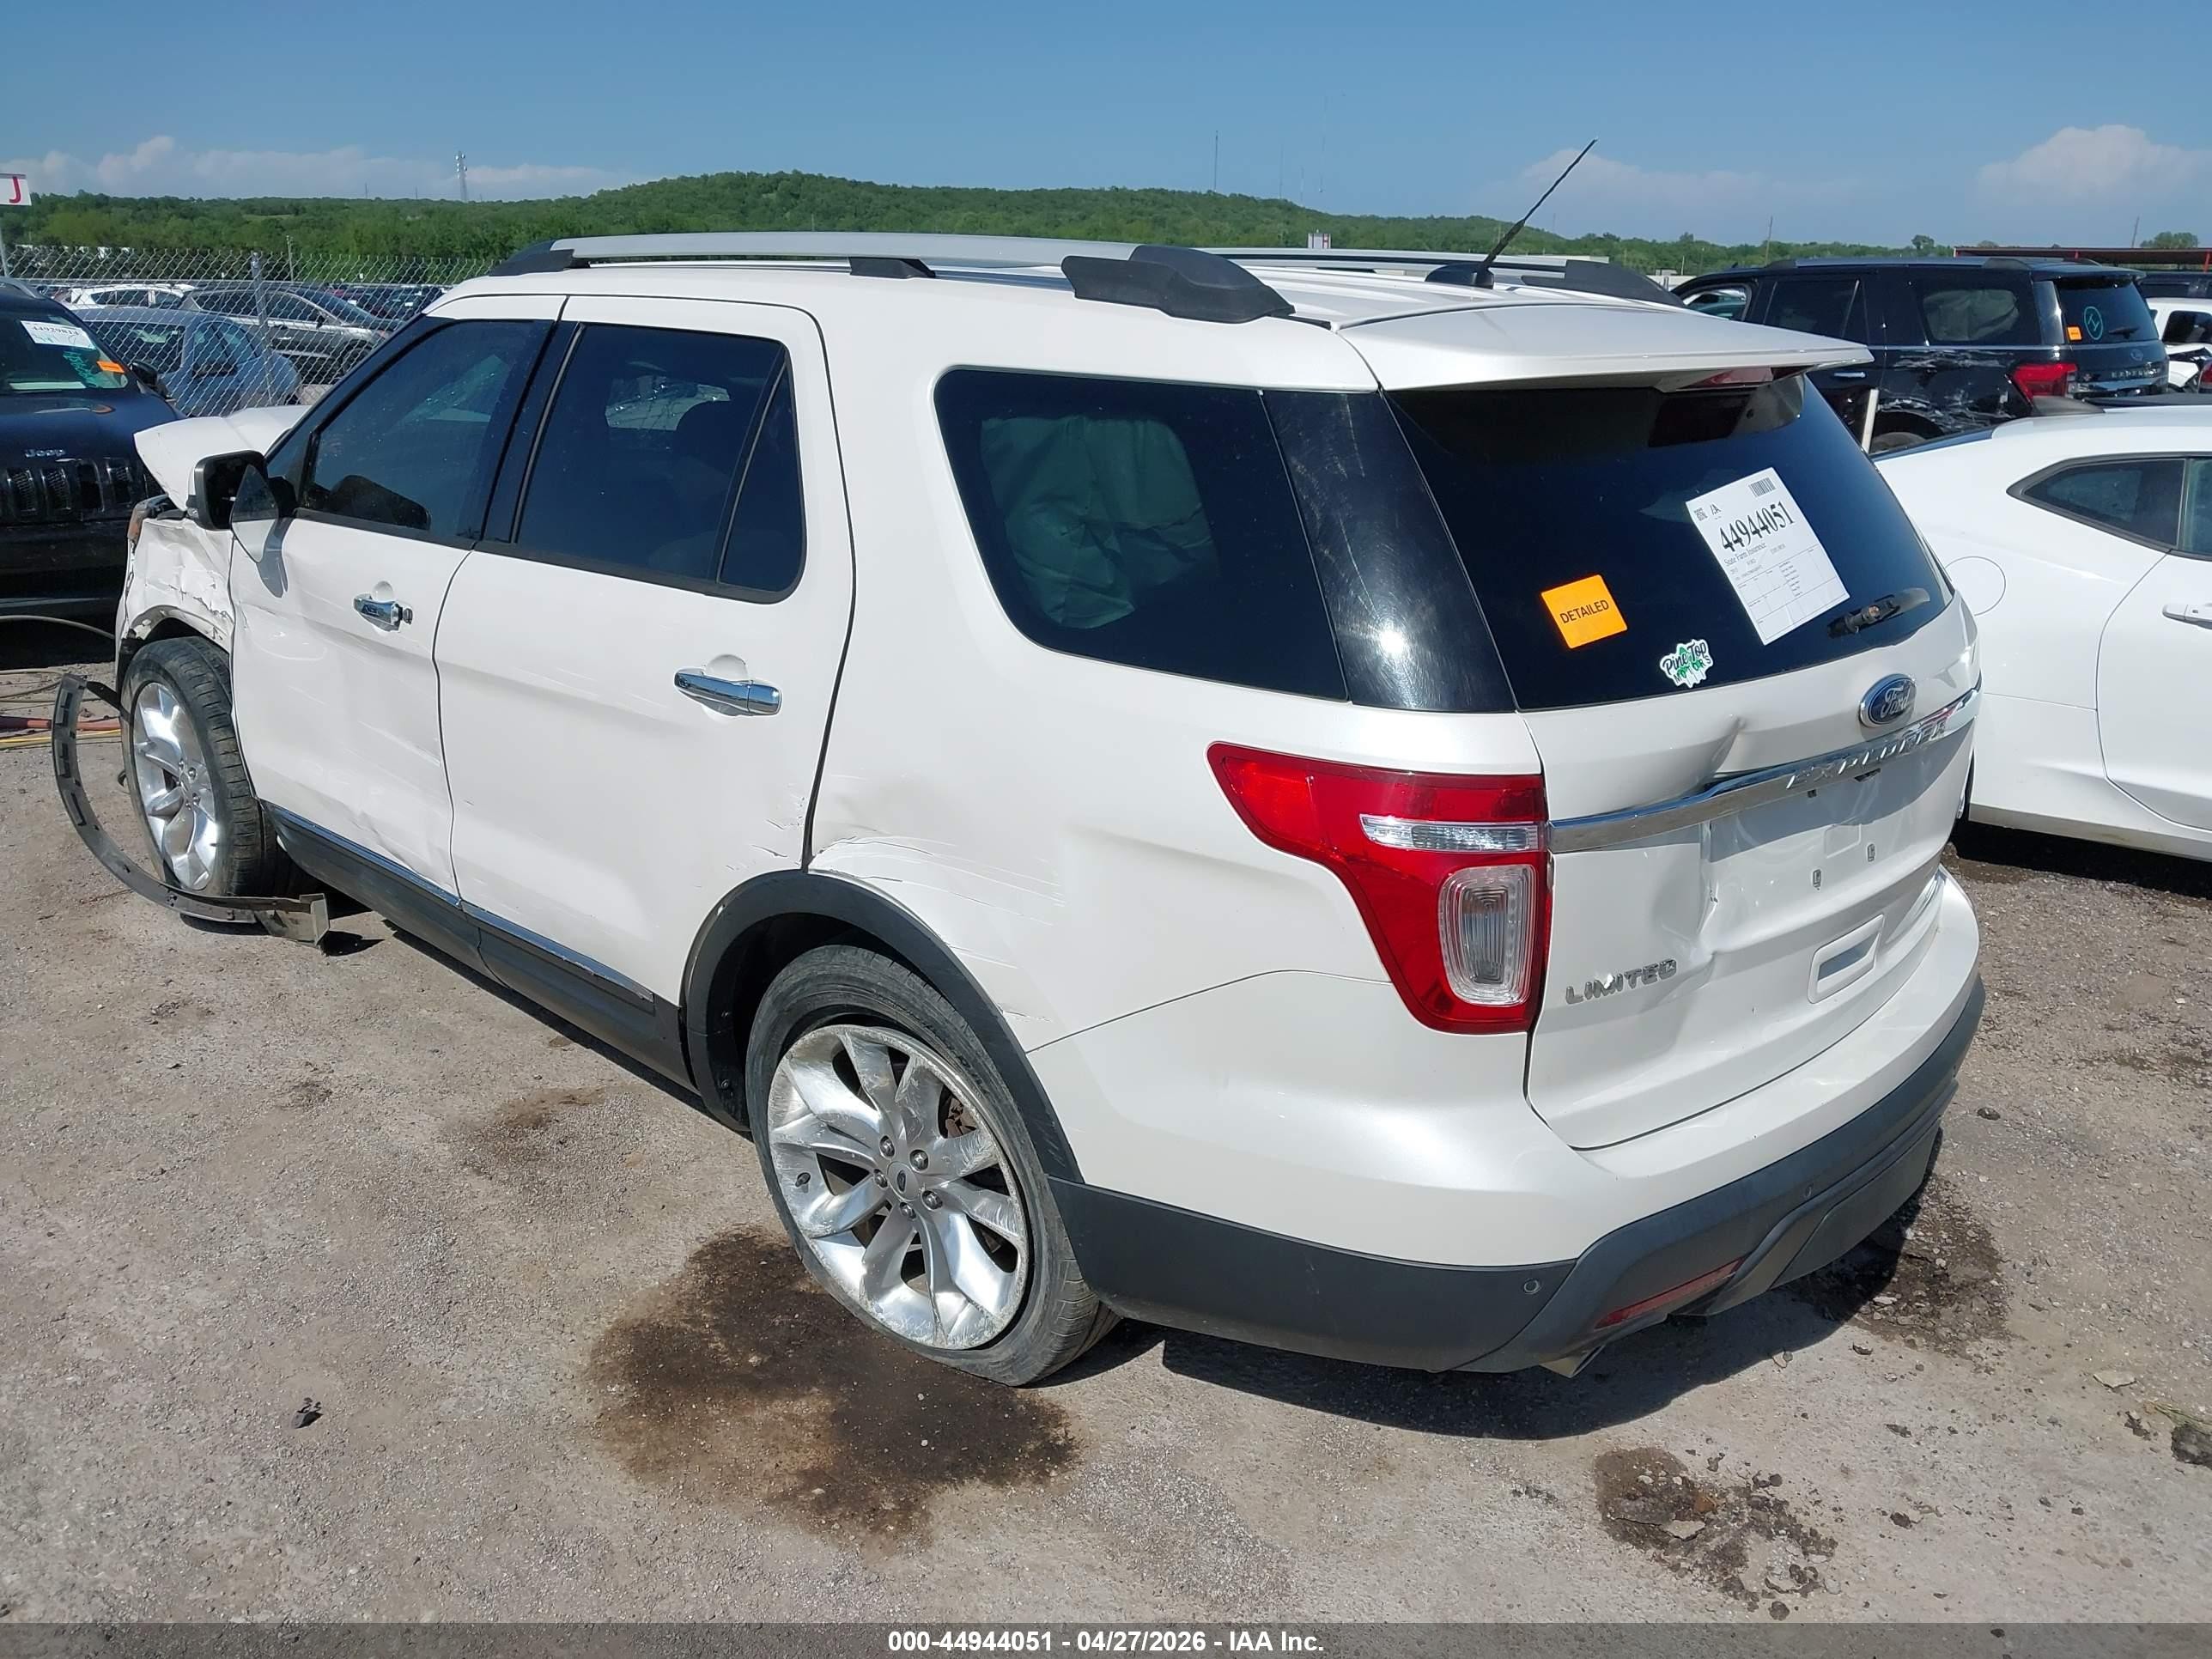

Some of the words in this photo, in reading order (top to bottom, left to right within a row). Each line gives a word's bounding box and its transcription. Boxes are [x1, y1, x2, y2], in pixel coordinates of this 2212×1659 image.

[9, 175, 21, 204] J
[24, 448, 66, 458] Jeep
[1719, 501, 1795, 552] 44944051
[1559, 599, 1609, 623] DETAILED
[1662, 653, 1688, 676] Pine
[1687, 642, 1707, 662] Top
[1880, 684, 1911, 719] Ford
[1785, 720, 1948, 789] EXPLORER
[1565, 959, 1676, 1004] LIMITED
